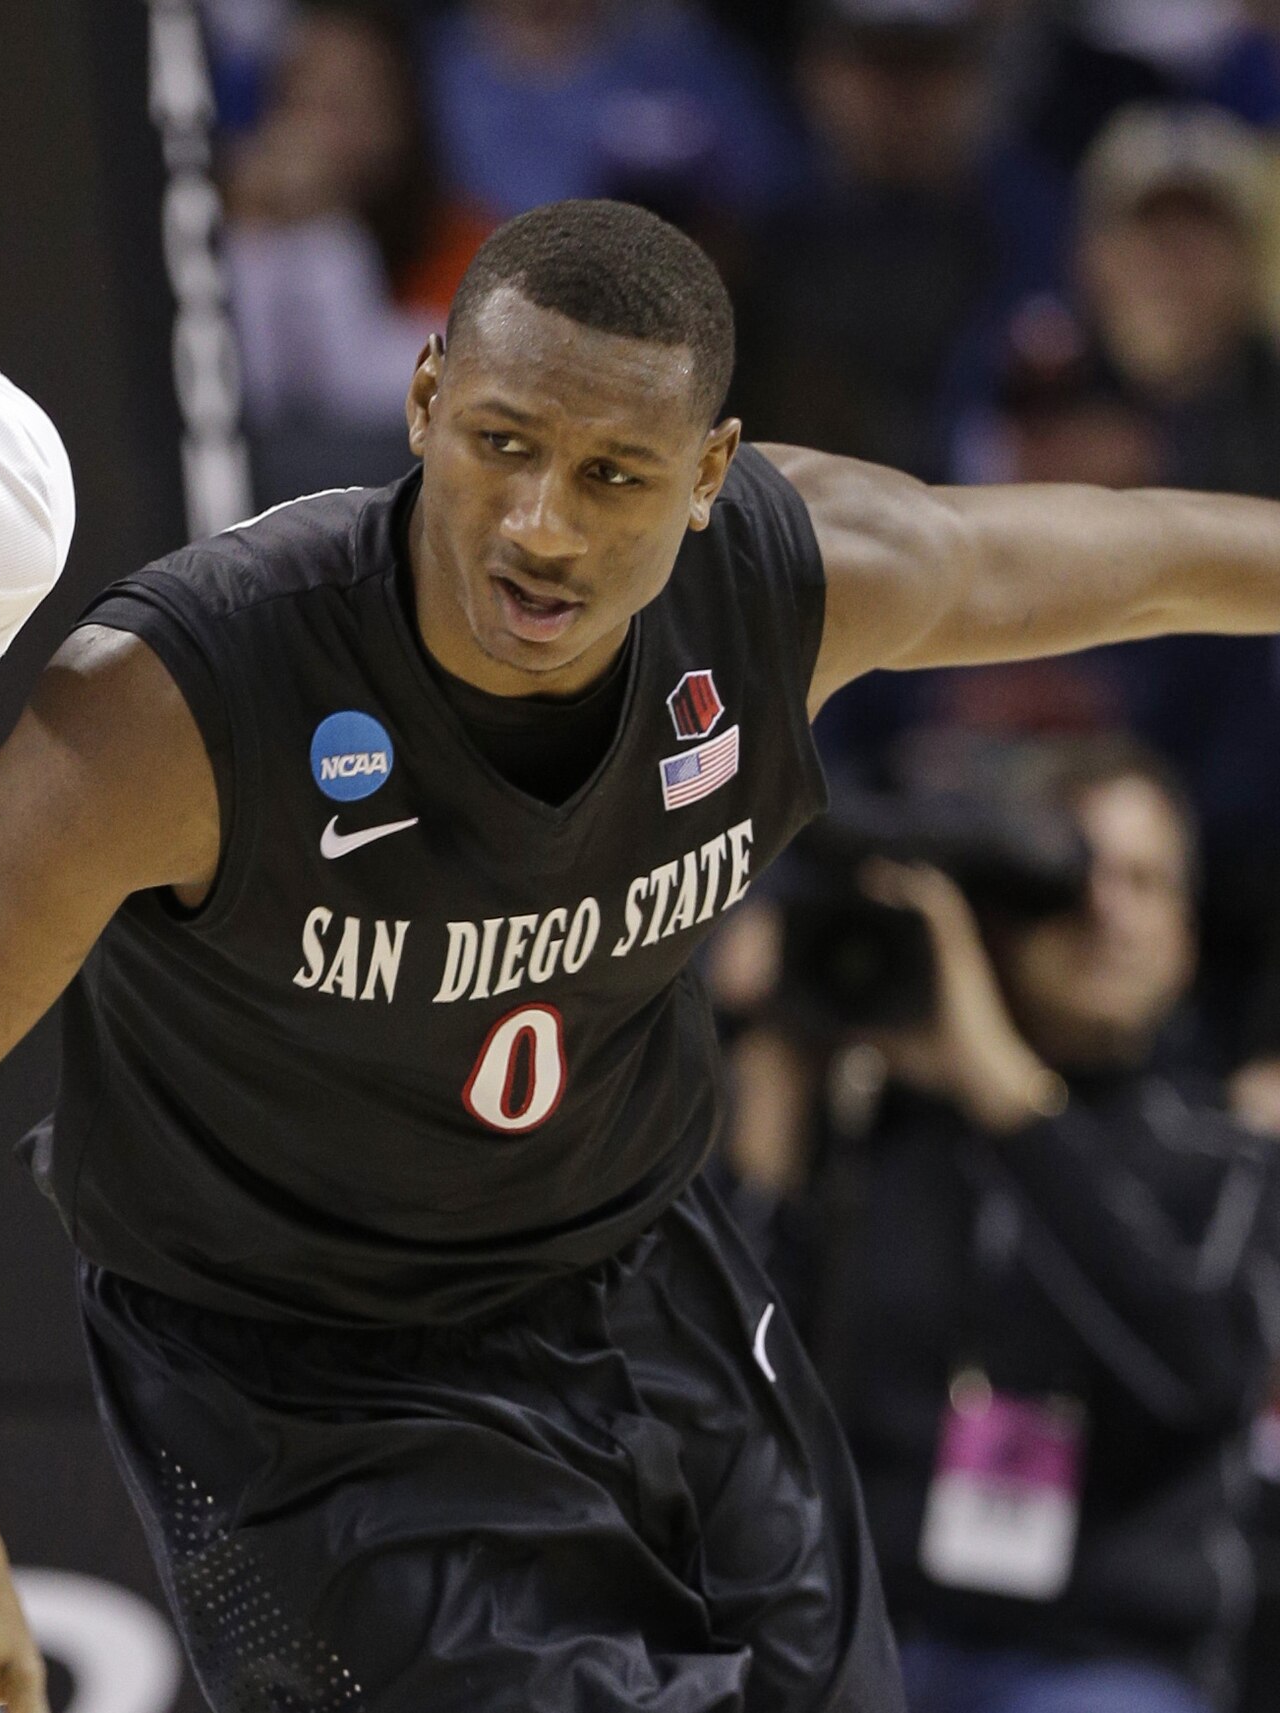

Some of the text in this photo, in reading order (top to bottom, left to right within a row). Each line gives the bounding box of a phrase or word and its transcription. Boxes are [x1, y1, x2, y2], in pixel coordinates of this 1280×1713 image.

[320, 750, 388, 780] NCAA
[293, 819, 754, 1004] SAN DIEGO STATE
[462, 1001, 567, 1135] 0
